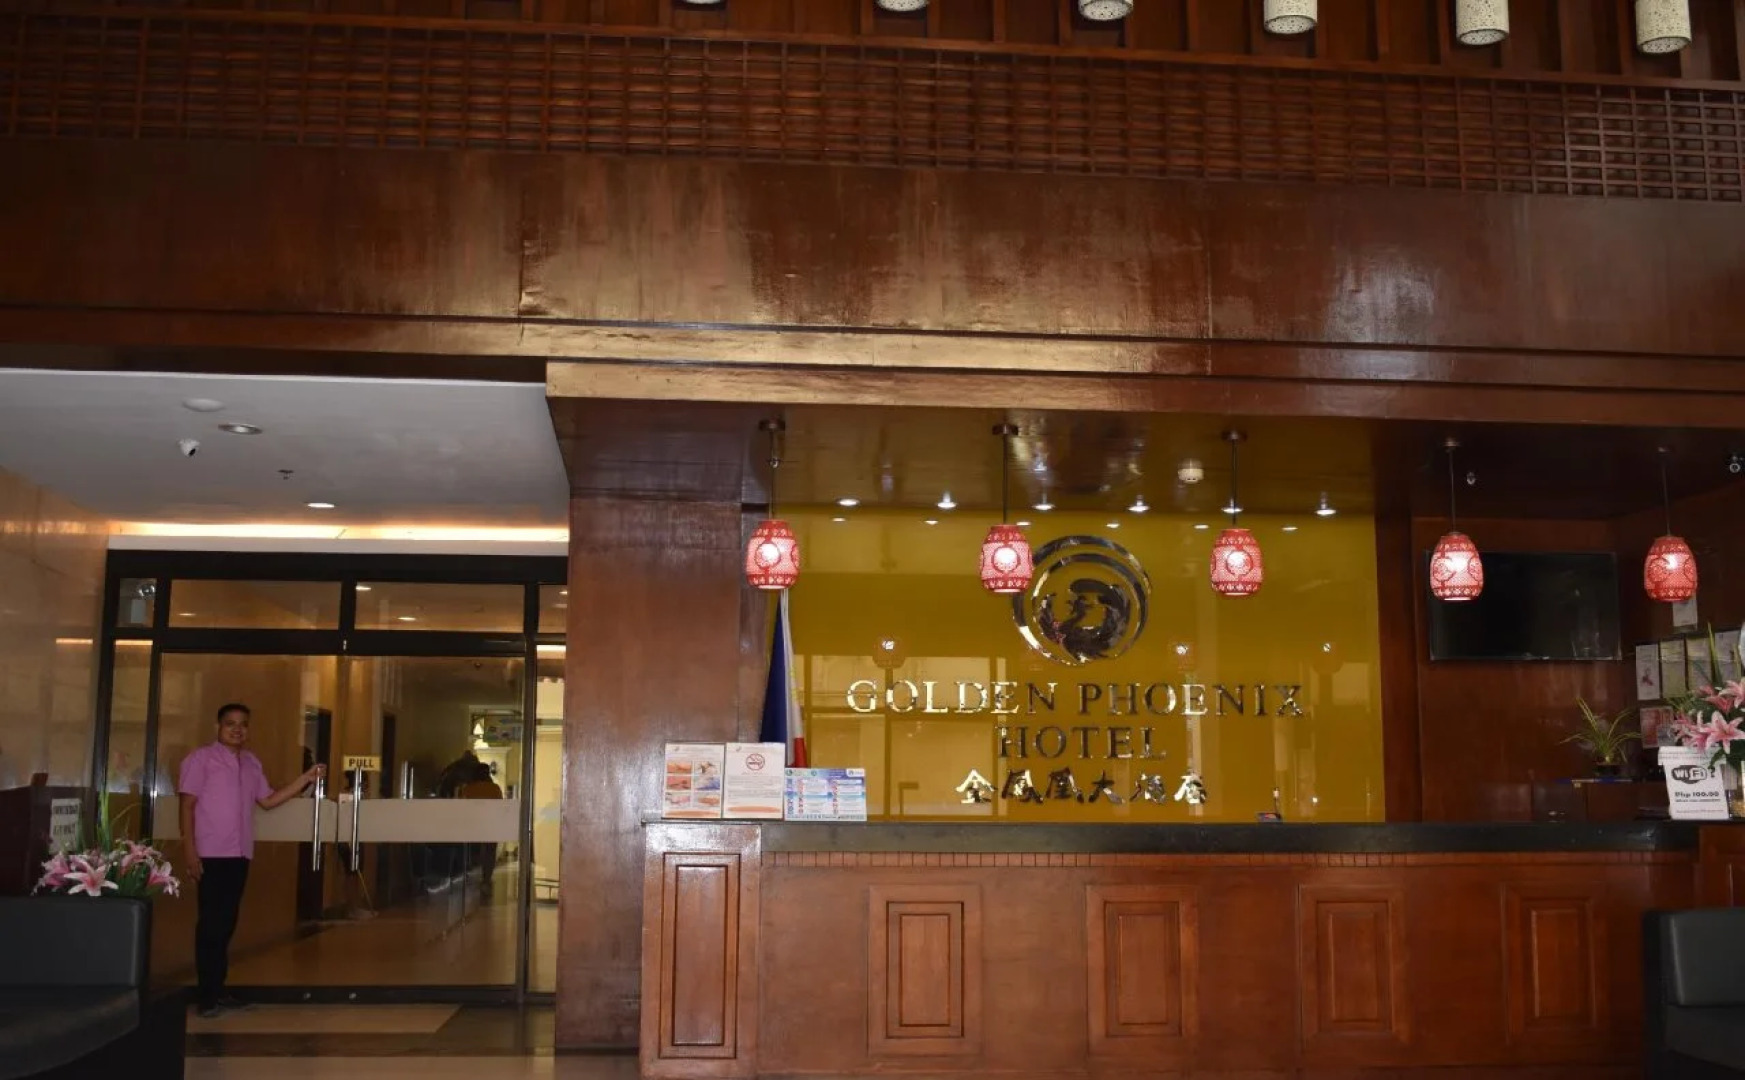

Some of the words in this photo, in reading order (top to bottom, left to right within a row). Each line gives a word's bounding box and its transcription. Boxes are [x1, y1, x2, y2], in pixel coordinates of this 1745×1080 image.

[846, 680, 1059, 714] GOLDEN
[1078, 683, 1306, 716] PHOENIX
[998, 725, 1168, 760] HOTEL
[349, 758, 374, 768] PULL
